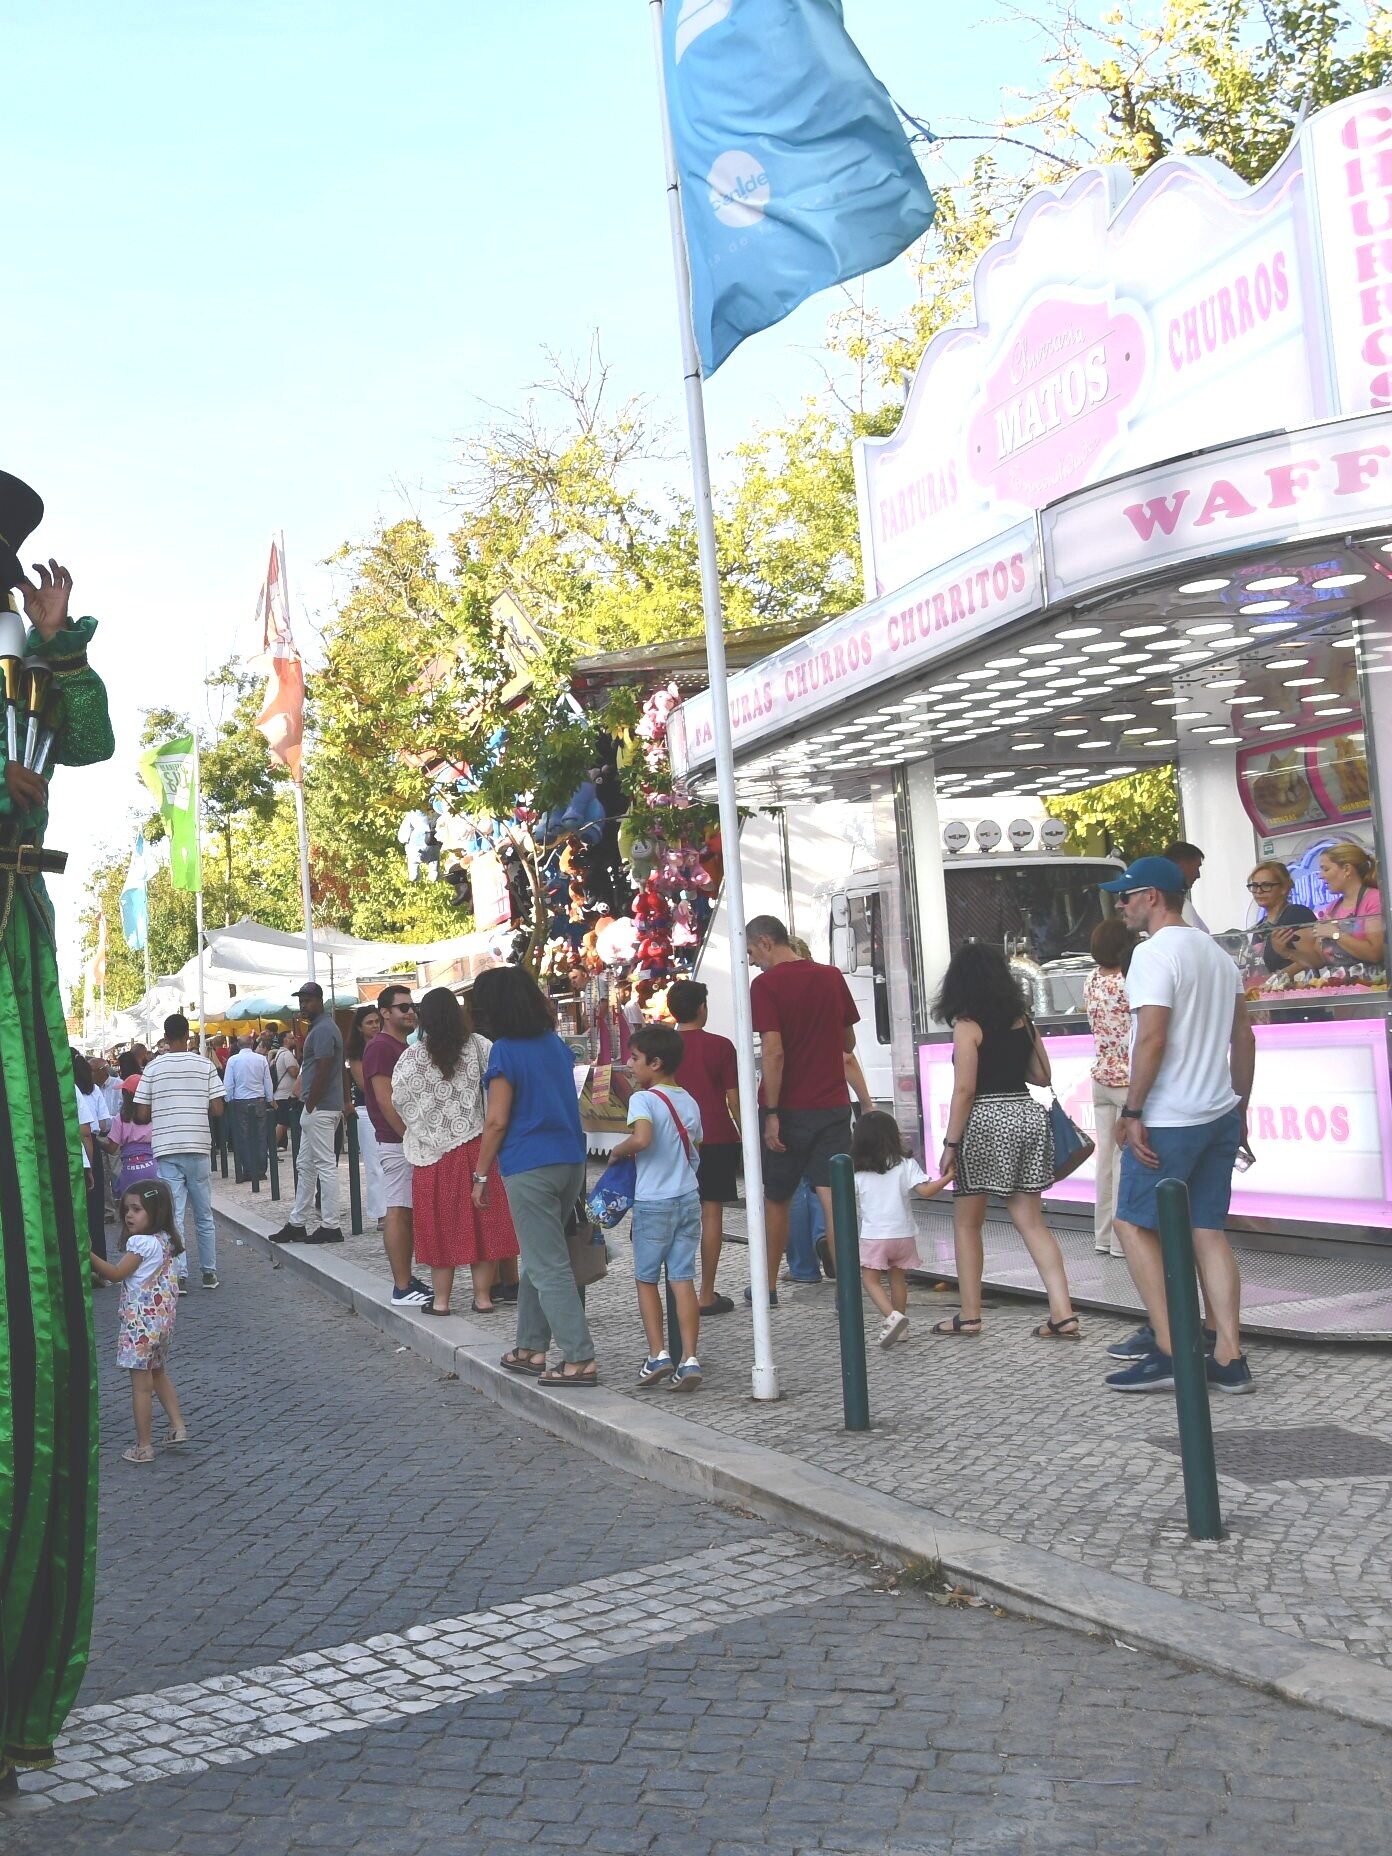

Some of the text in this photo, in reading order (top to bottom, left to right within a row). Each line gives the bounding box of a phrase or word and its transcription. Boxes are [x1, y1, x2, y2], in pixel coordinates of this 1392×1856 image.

[1168, 251, 1290, 372] CHURROS
[996, 343, 1109, 462] MATOS
[879, 457, 958, 543] FARTURAS
[694, 552, 1026, 747] FAURAS CHURROS CHURRITOS
